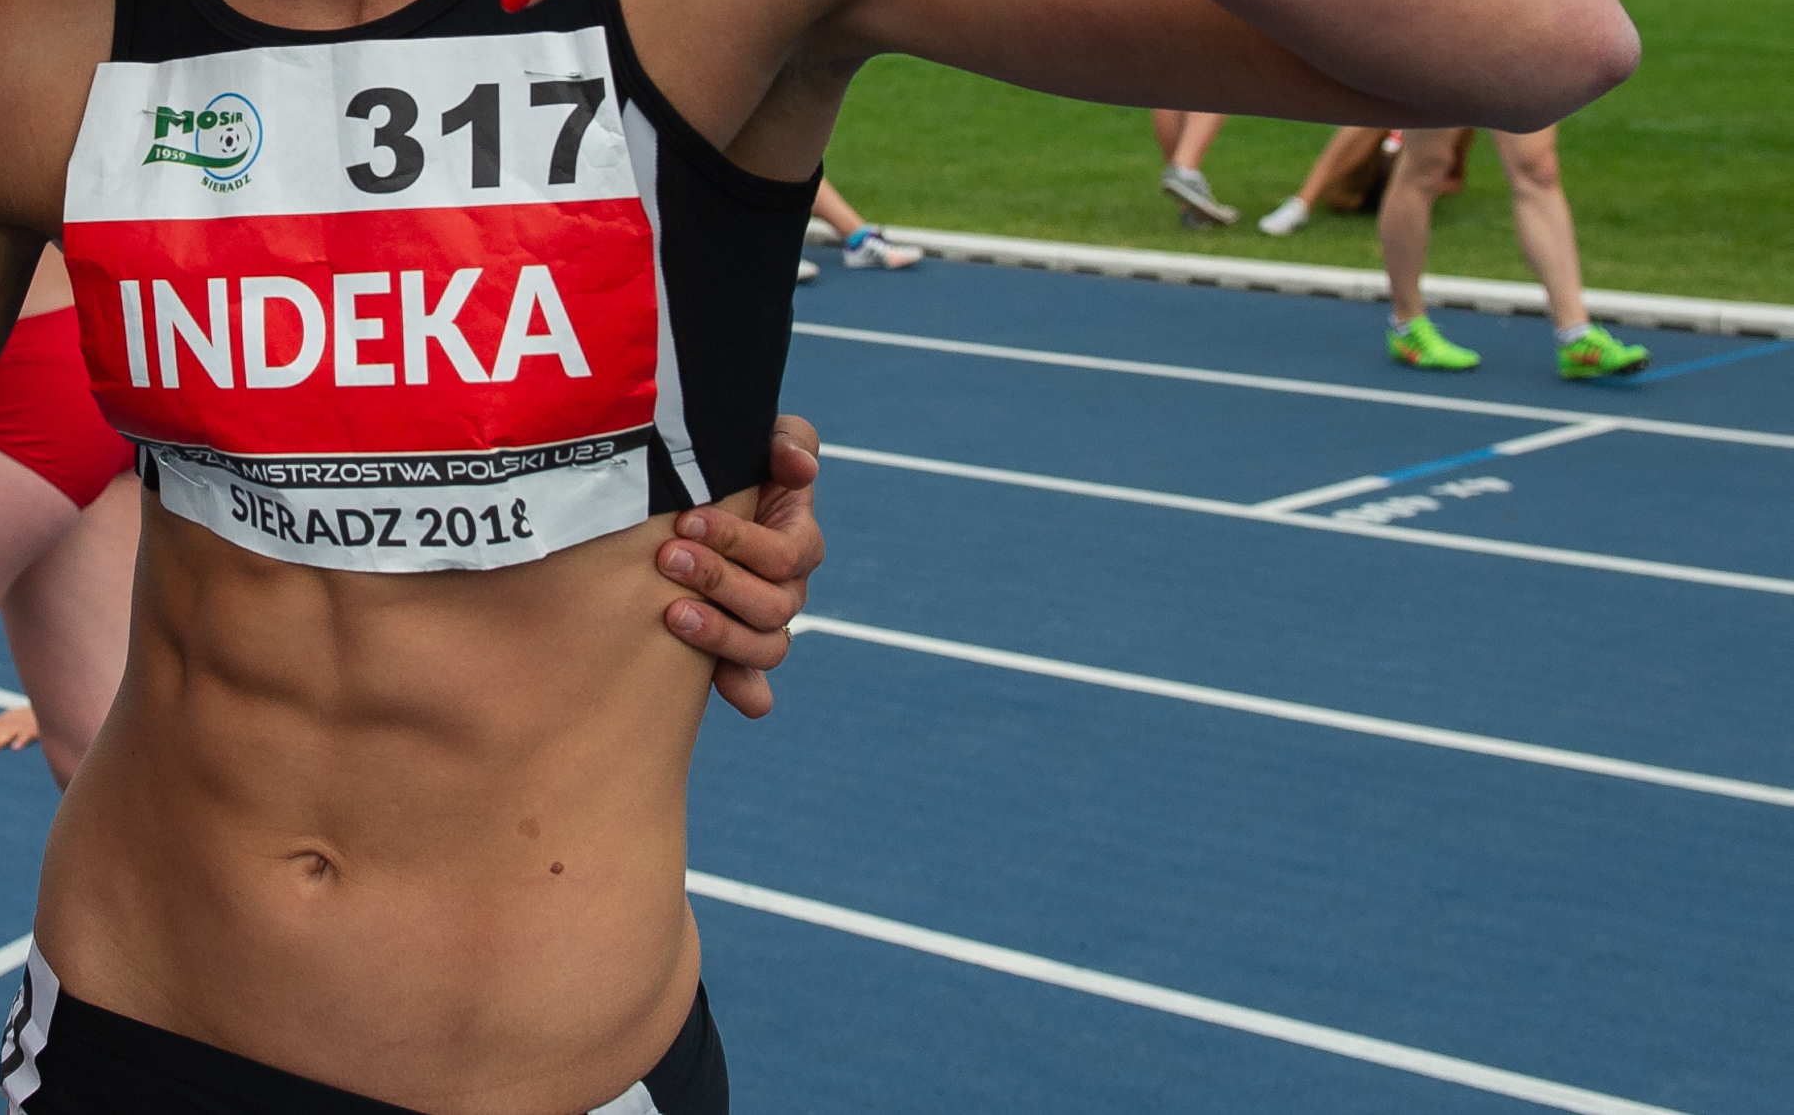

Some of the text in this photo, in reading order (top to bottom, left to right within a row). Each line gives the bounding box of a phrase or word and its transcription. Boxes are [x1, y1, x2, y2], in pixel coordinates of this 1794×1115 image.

[155, 147, 186, 161] 1959
[345, 76, 606, 195] 317
[200, 173, 252, 194] SIERADZ
[118, 263, 593, 390] INDEKA
[241, 461, 442, 484] MISTRZOSTWA
[446, 452, 546, 481] POLSKI
[554, 440, 615, 464] U23
[228, 482, 534, 548] SIERADZ 2018
